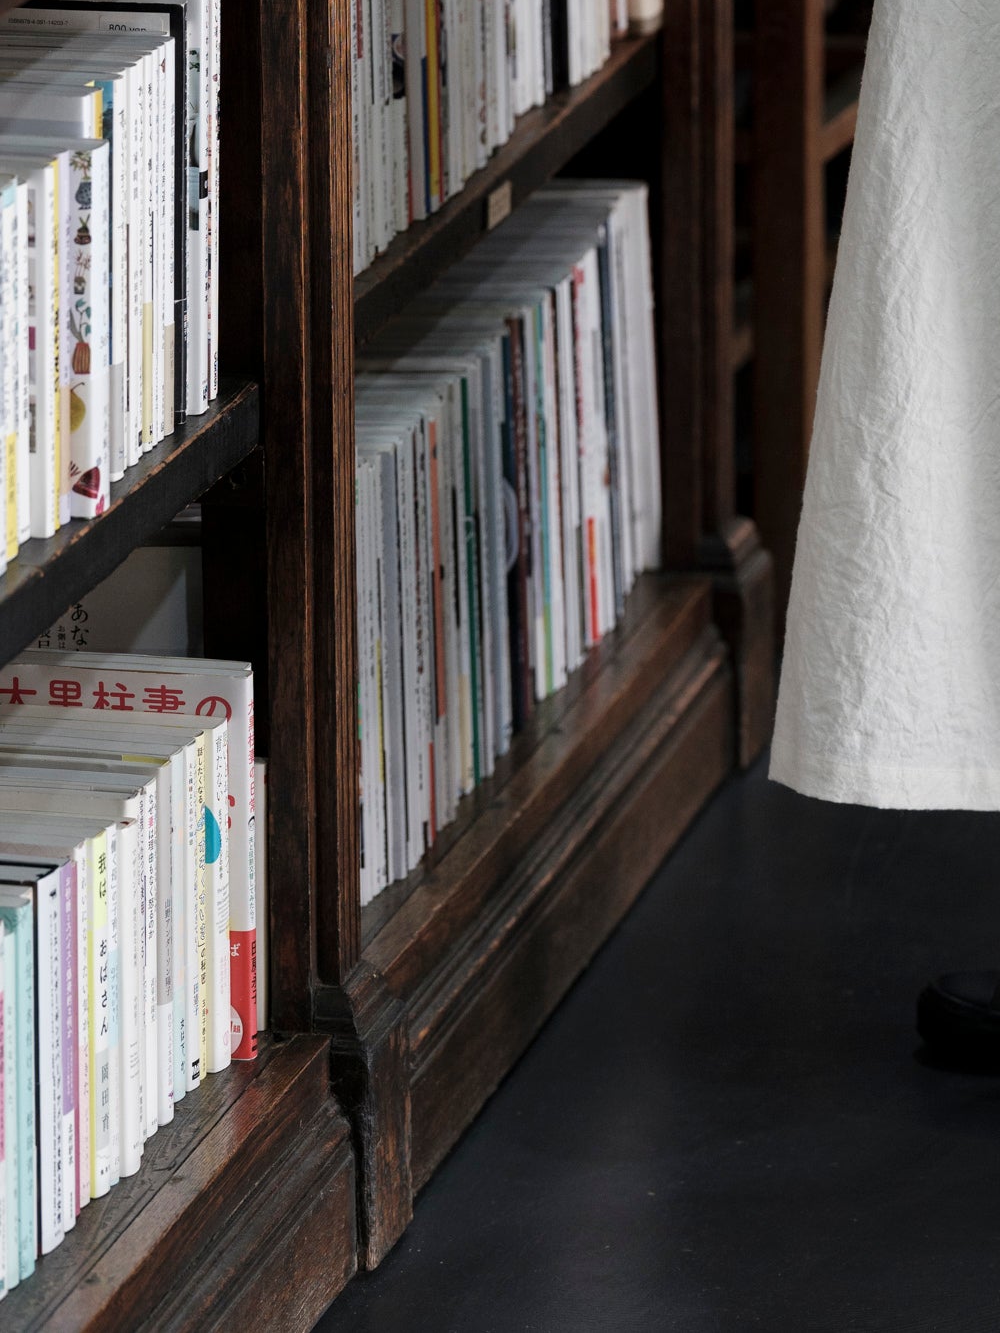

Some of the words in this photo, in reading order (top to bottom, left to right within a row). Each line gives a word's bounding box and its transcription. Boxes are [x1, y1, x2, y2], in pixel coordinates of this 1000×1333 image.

[71, 603, 89, 652] あな
[99, 939, 108, 1036] おばさん
